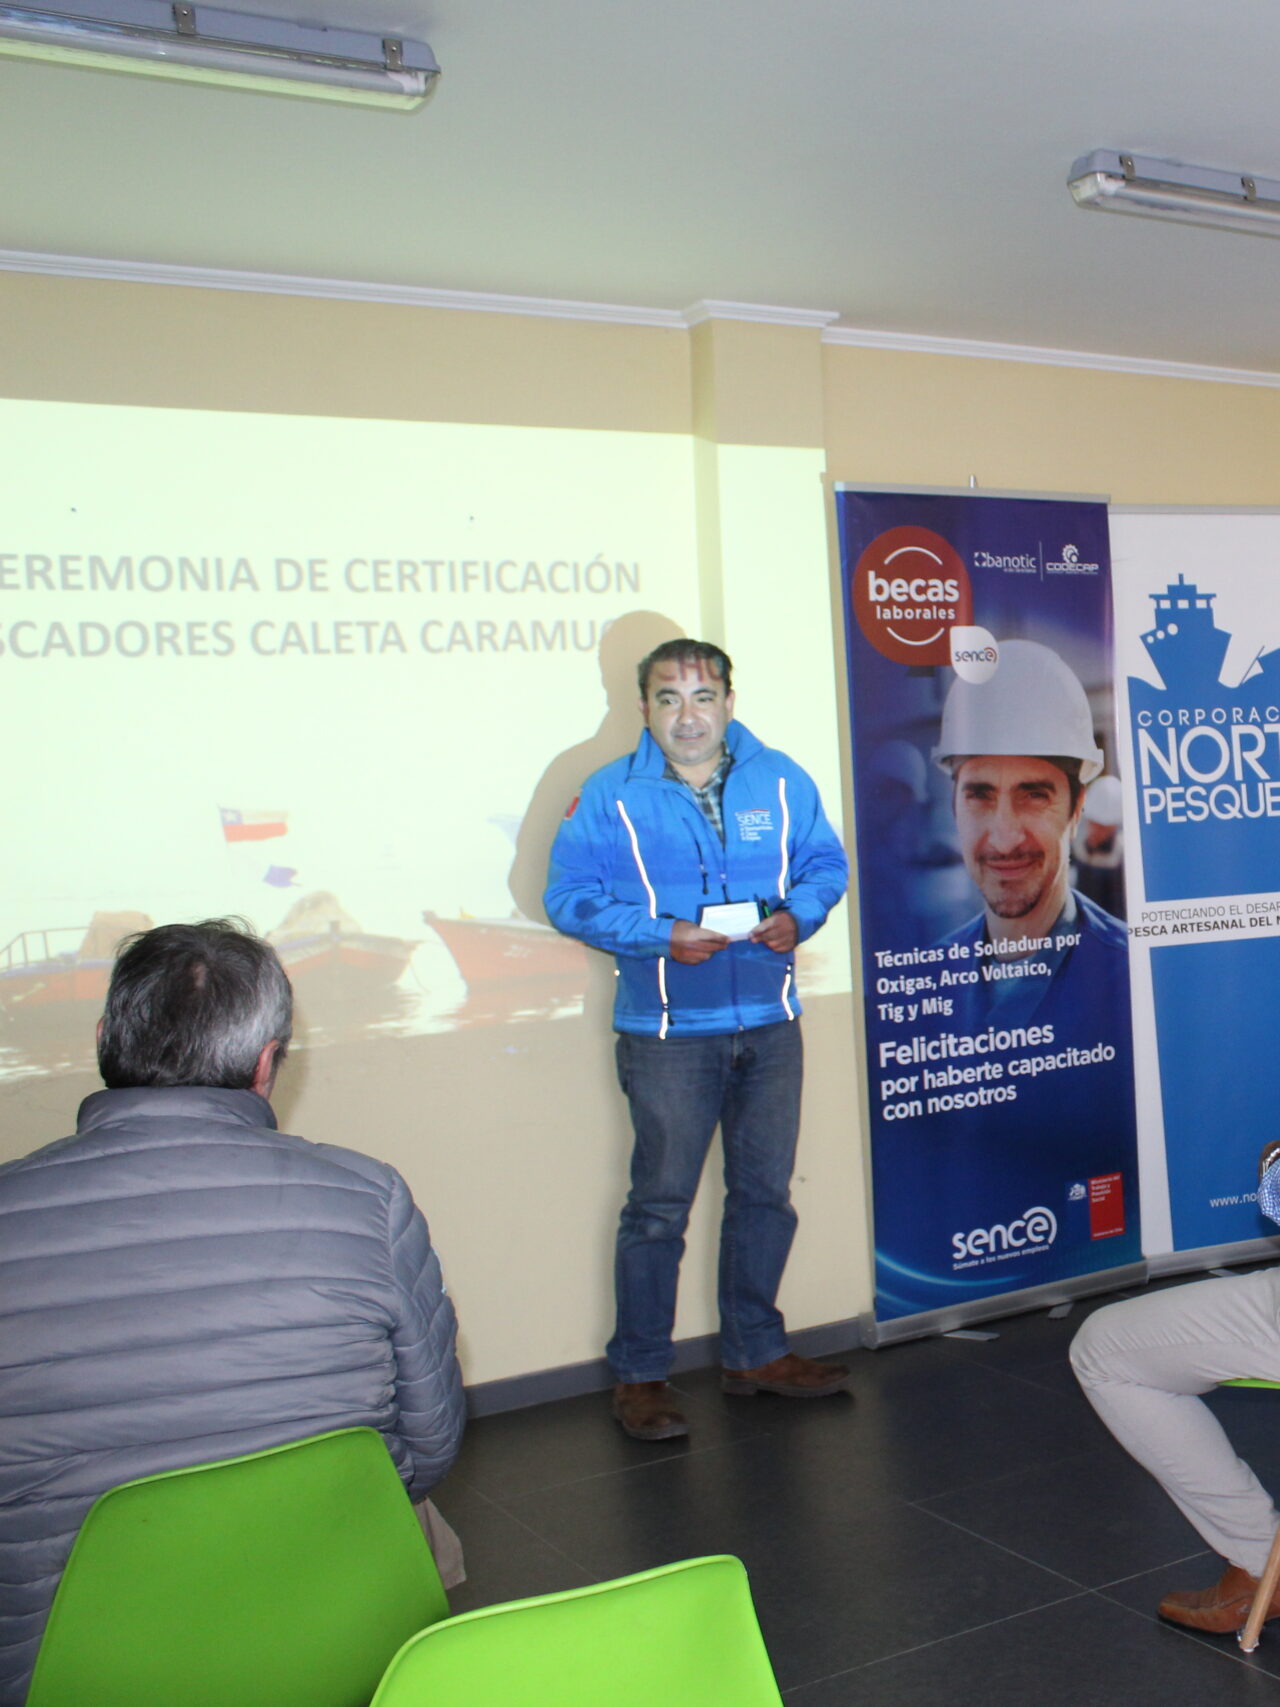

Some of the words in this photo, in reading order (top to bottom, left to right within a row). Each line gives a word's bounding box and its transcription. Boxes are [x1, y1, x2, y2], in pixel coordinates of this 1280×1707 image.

[0, 553, 259, 592] EREMONIA
[274, 557, 330, 593] DE
[342, 553, 641, 594] CERTIFICACIÓN
[868, 571, 959, 602] becas
[876, 606, 956, 620] laborales
[250, 619, 406, 655] CALETA
[419, 618, 613, 653] CARAMU
[1141, 905, 1226, 923] POTENCIANDO
[1229, 904, 1243, 916] EL
[1171, 919, 1247, 935] ARTESANAL
[1249, 915, 1273, 928] DEL
[875, 947, 945, 968] Técnicas
[948, 943, 970, 959] de
[973, 934, 1053, 958] Soldadura
[1055, 931, 1082, 950] por
[876, 974, 938, 994] Oxigas,
[940, 968, 980, 986] Arco
[982, 960, 1052, 982] Voltaico,
[877, 1003, 904, 1023] Tig
[907, 1004, 919, 1021] y
[921, 996, 954, 1016] Mig
[879, 1023, 1055, 1068] Felicitaciones
[881, 1075, 920, 1100] por
[923, 1061, 1004, 1090] haberte
[1007, 1042, 1116, 1077] capacitado
[882, 1099, 923, 1121] con
[927, 1083, 1018, 1114] nosotros
[1209, 1192, 1258, 1207] www.no
[952, 1206, 1057, 1259] sence
